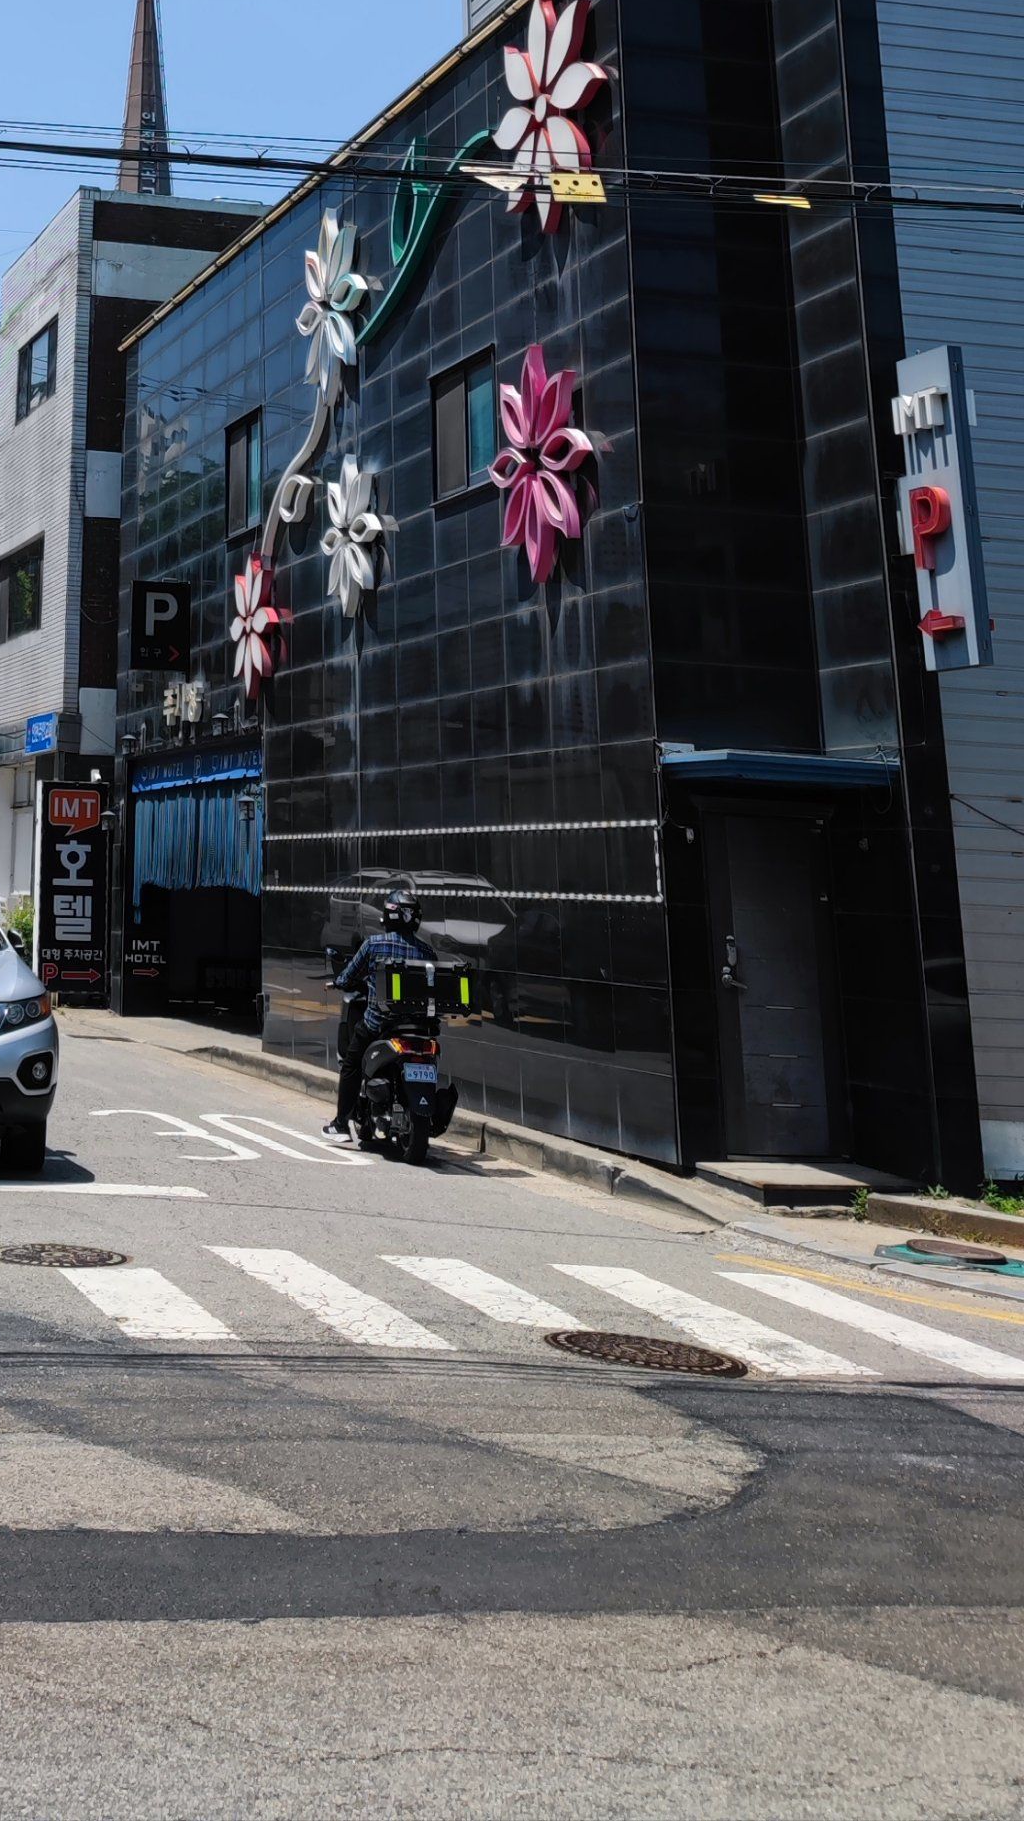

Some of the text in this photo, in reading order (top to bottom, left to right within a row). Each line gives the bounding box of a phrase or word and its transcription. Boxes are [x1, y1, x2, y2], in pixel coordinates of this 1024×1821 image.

[891, 386, 946, 435] IMT
[909, 486, 951, 571] P
[145, 591, 179, 637] P
[53, 796, 96, 819] IMT
[52, 839, 94, 942] 호텔
[41, 948, 104, 962] 대형 주차공간
[132, 939, 161, 952] IMT
[125, 953, 167, 965] HOTEL
[42, 963, 59, 987] P
[413, 1070, 434, 1080] 9790
[88, 1109, 376, 1166] 30
